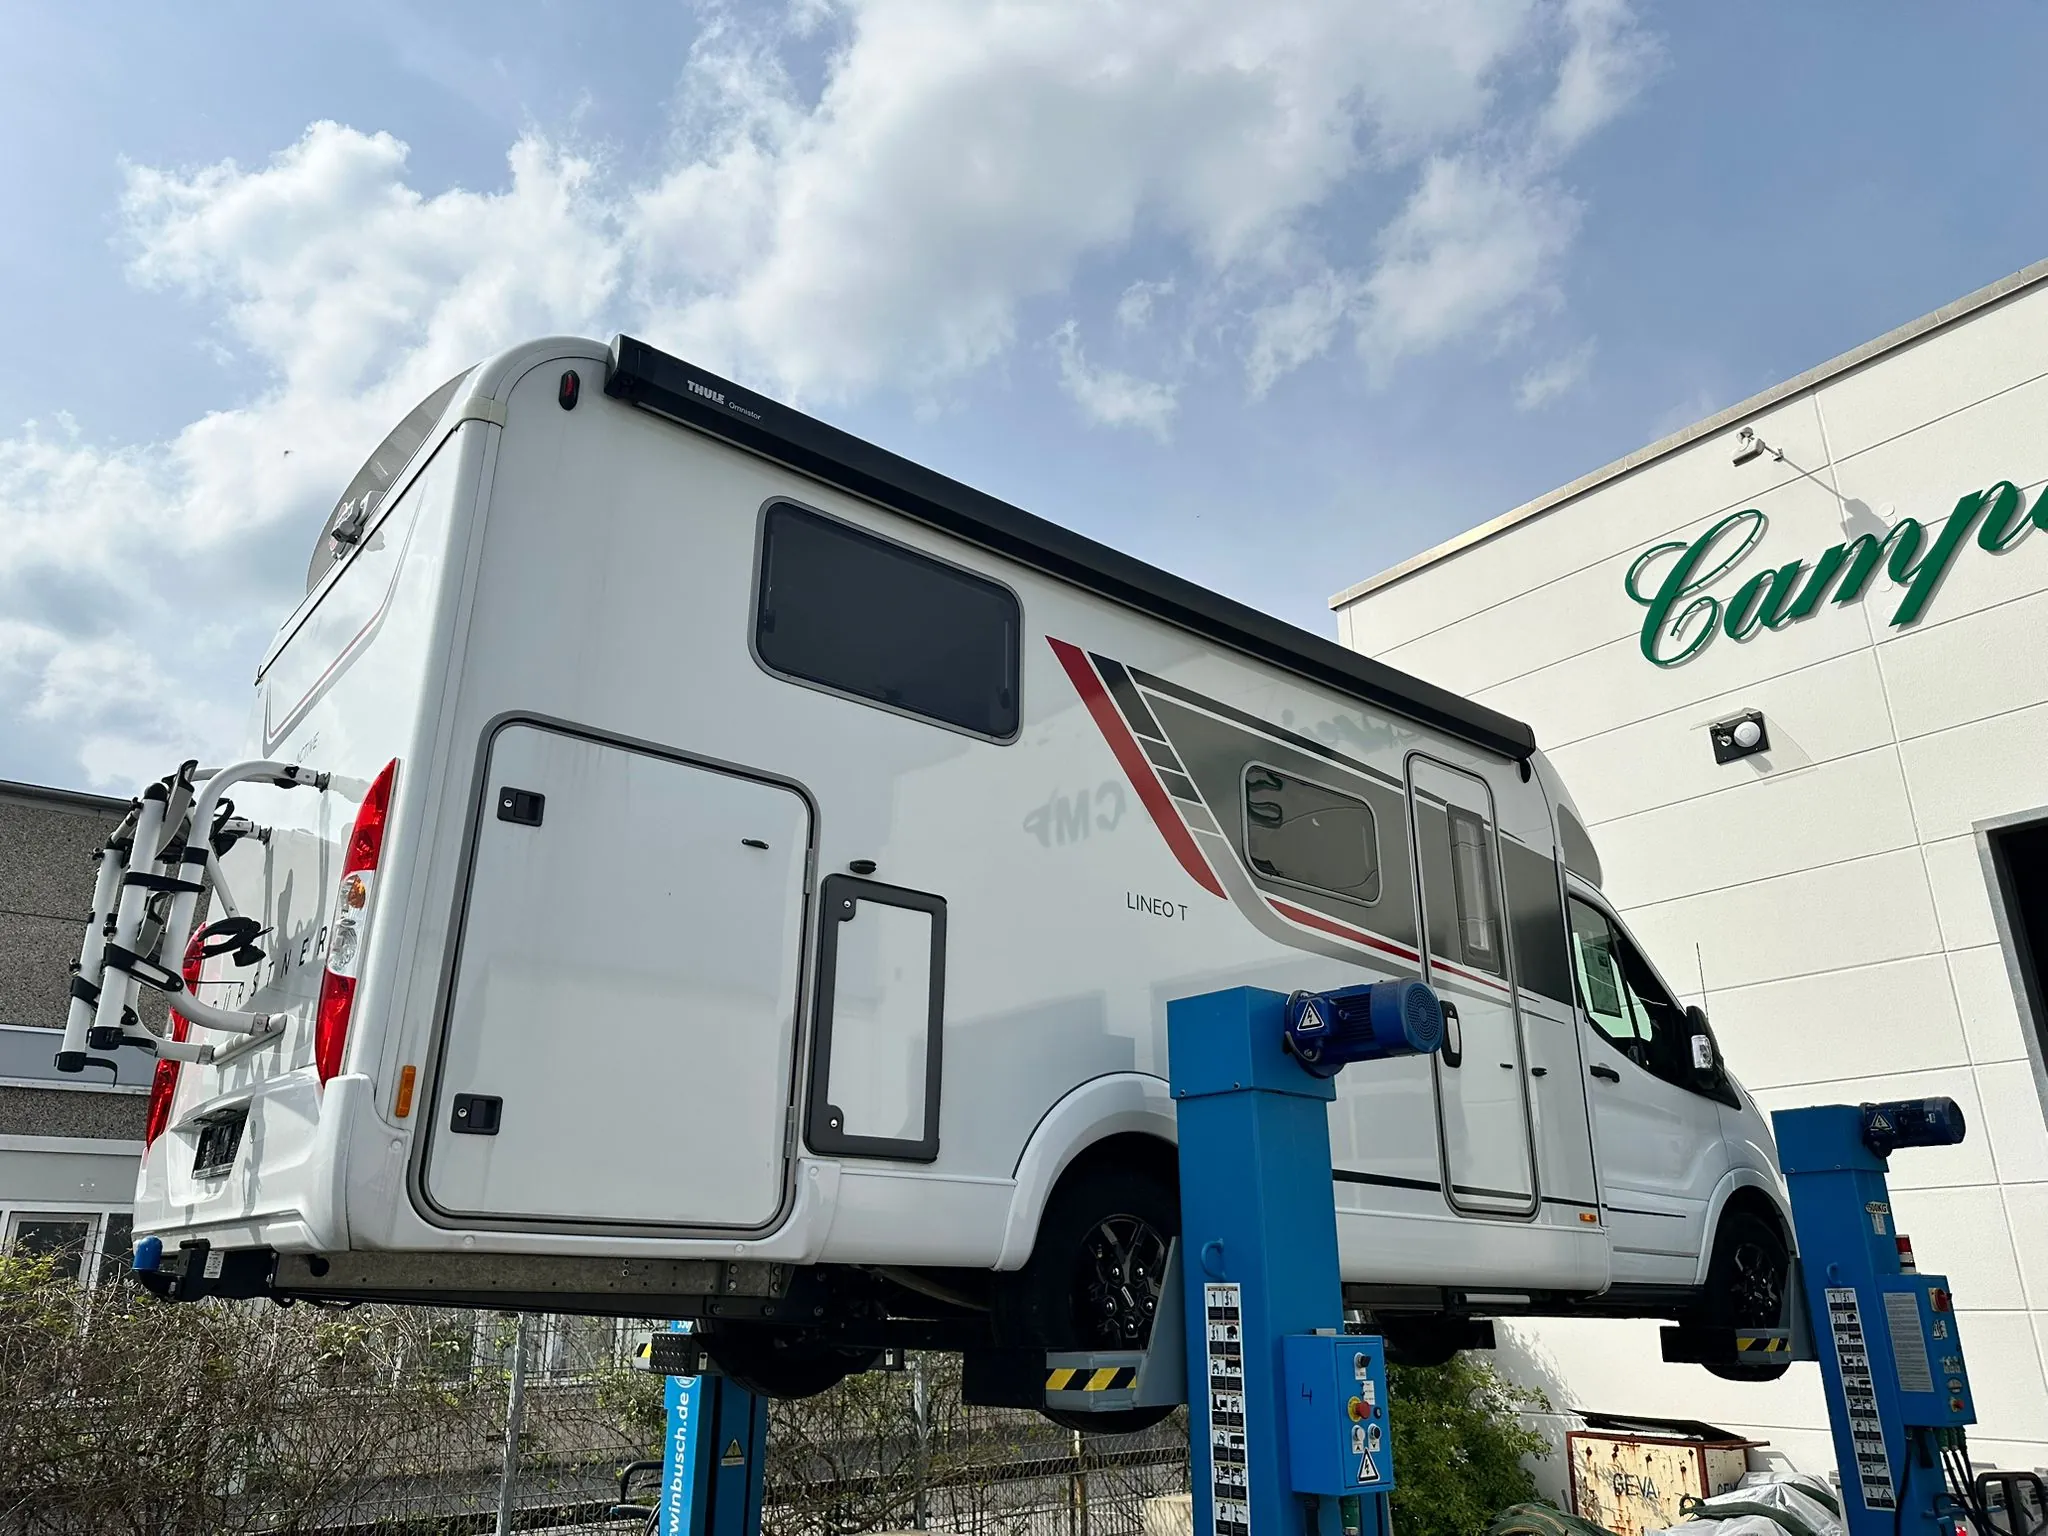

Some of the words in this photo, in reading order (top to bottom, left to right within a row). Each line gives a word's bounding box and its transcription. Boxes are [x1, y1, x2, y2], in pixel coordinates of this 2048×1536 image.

[687, 380, 725, 405] THULE
[728, 401, 761, 420] Omnistor
[1624, 480, 2048, 667] Camp
[1126, 891, 1174, 918] LINEO
[1177, 903, 1188, 921] T
[1301, 1383, 1313, 1406] 4
[1612, 1472, 1658, 1499] GEVA
